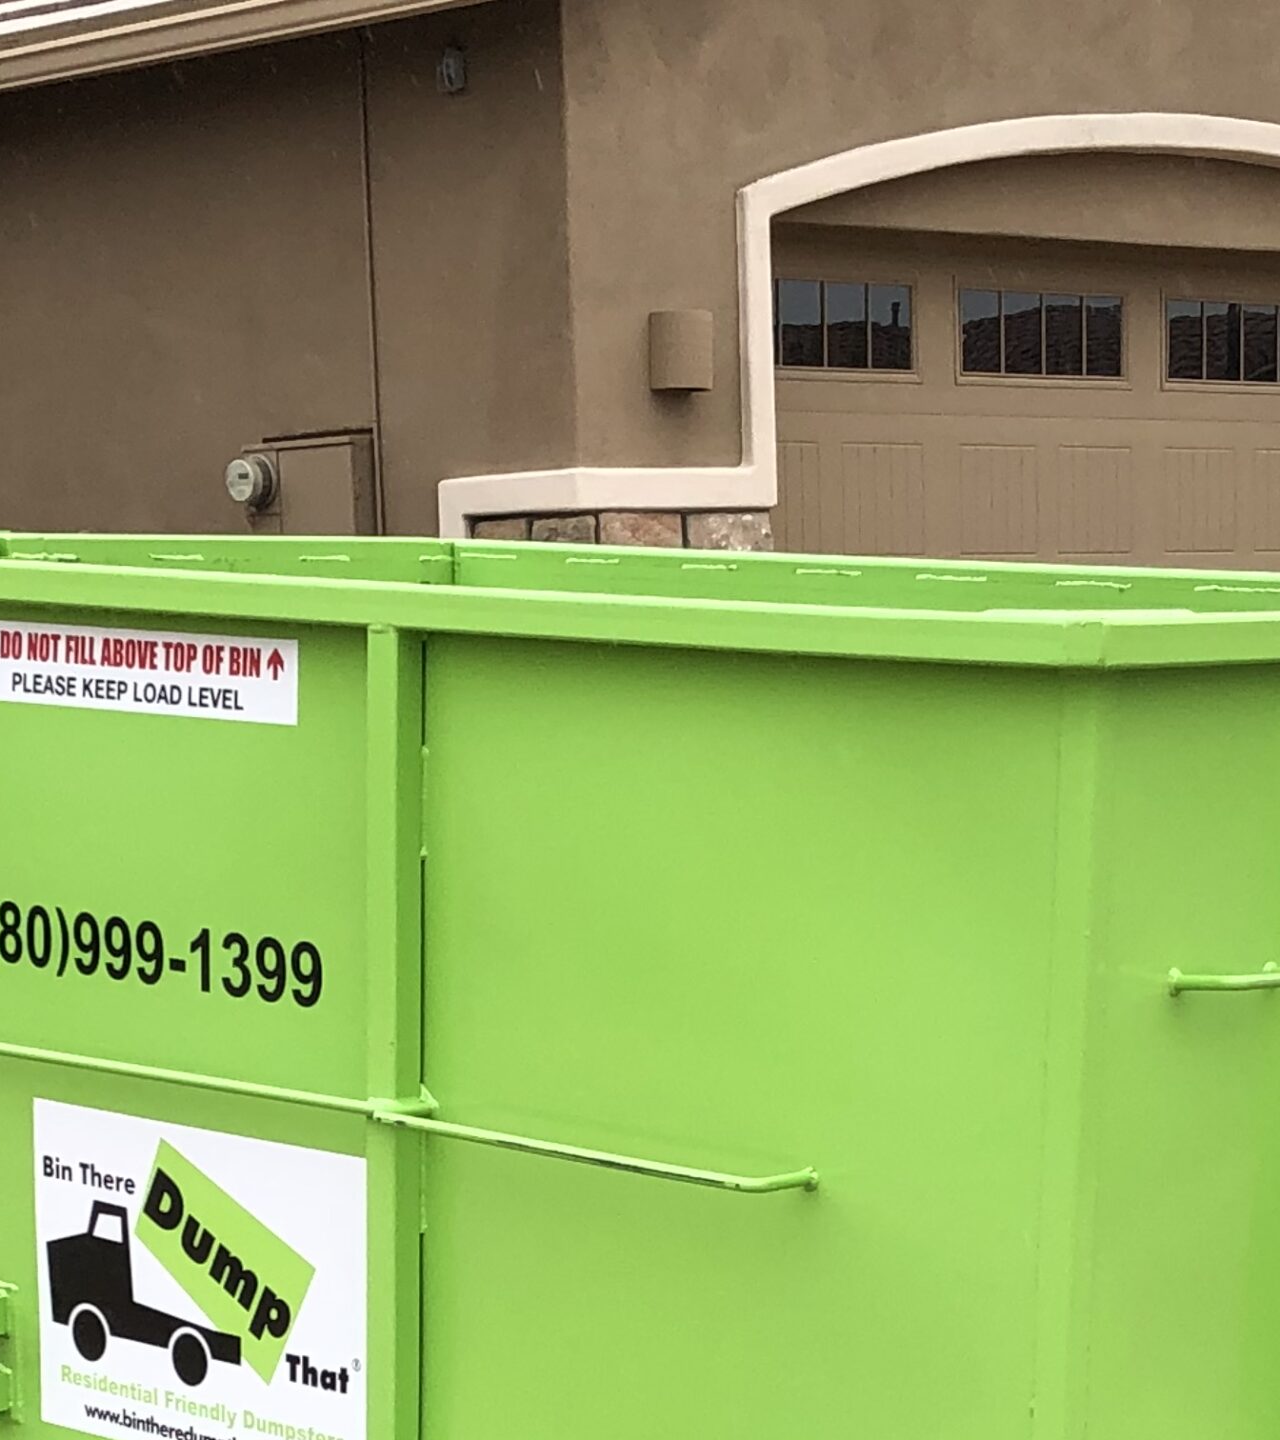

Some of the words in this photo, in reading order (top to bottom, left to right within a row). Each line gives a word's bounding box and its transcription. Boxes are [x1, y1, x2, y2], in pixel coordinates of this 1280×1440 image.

[0, 630, 22, 660] DO
[28, 632, 61, 663] NOT
[66, 635, 96, 665] FILL
[101, 638, 158, 670] ABOVE
[162, 641, 197, 673] TOP
[202, 644, 225, 675] OF
[229, 646, 261, 678] BIN
[12, 672, 77, 697] PLEASE
[82, 678, 128, 701] KEEP
[133, 682, 182, 705] LOAD
[188, 686, 244, 711] LEVEL
[43, 1155, 72, 1182] Bin
[79, 1162, 135, 1195] There
[143, 1167, 291, 1340] Dump
[286, 1353, 349, 1394] That
[61, 1364, 158, 1406] Residential
[165, 1392, 237, 1429] Friendly
